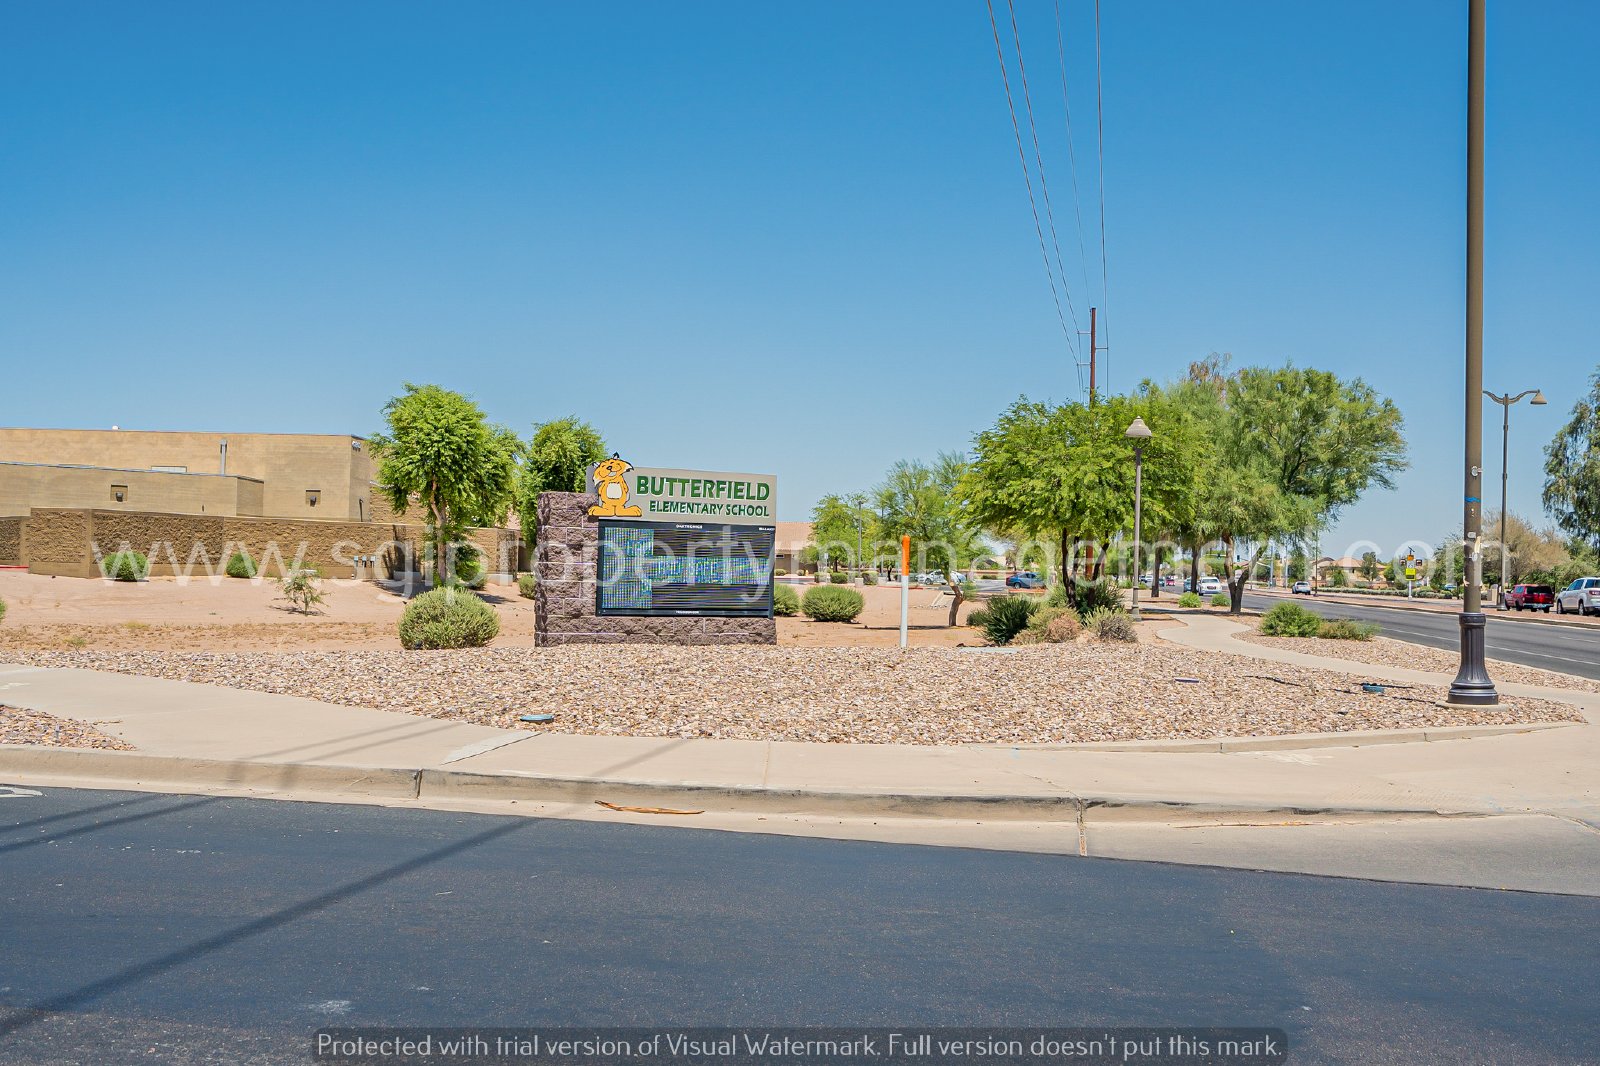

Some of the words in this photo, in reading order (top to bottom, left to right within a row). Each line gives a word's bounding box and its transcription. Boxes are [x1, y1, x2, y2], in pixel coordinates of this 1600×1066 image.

[636, 475, 770, 501] BUTTERFIELD
[649, 500, 724, 514] ELEMENTARY
[725, 505, 770, 517] SCHOOL
